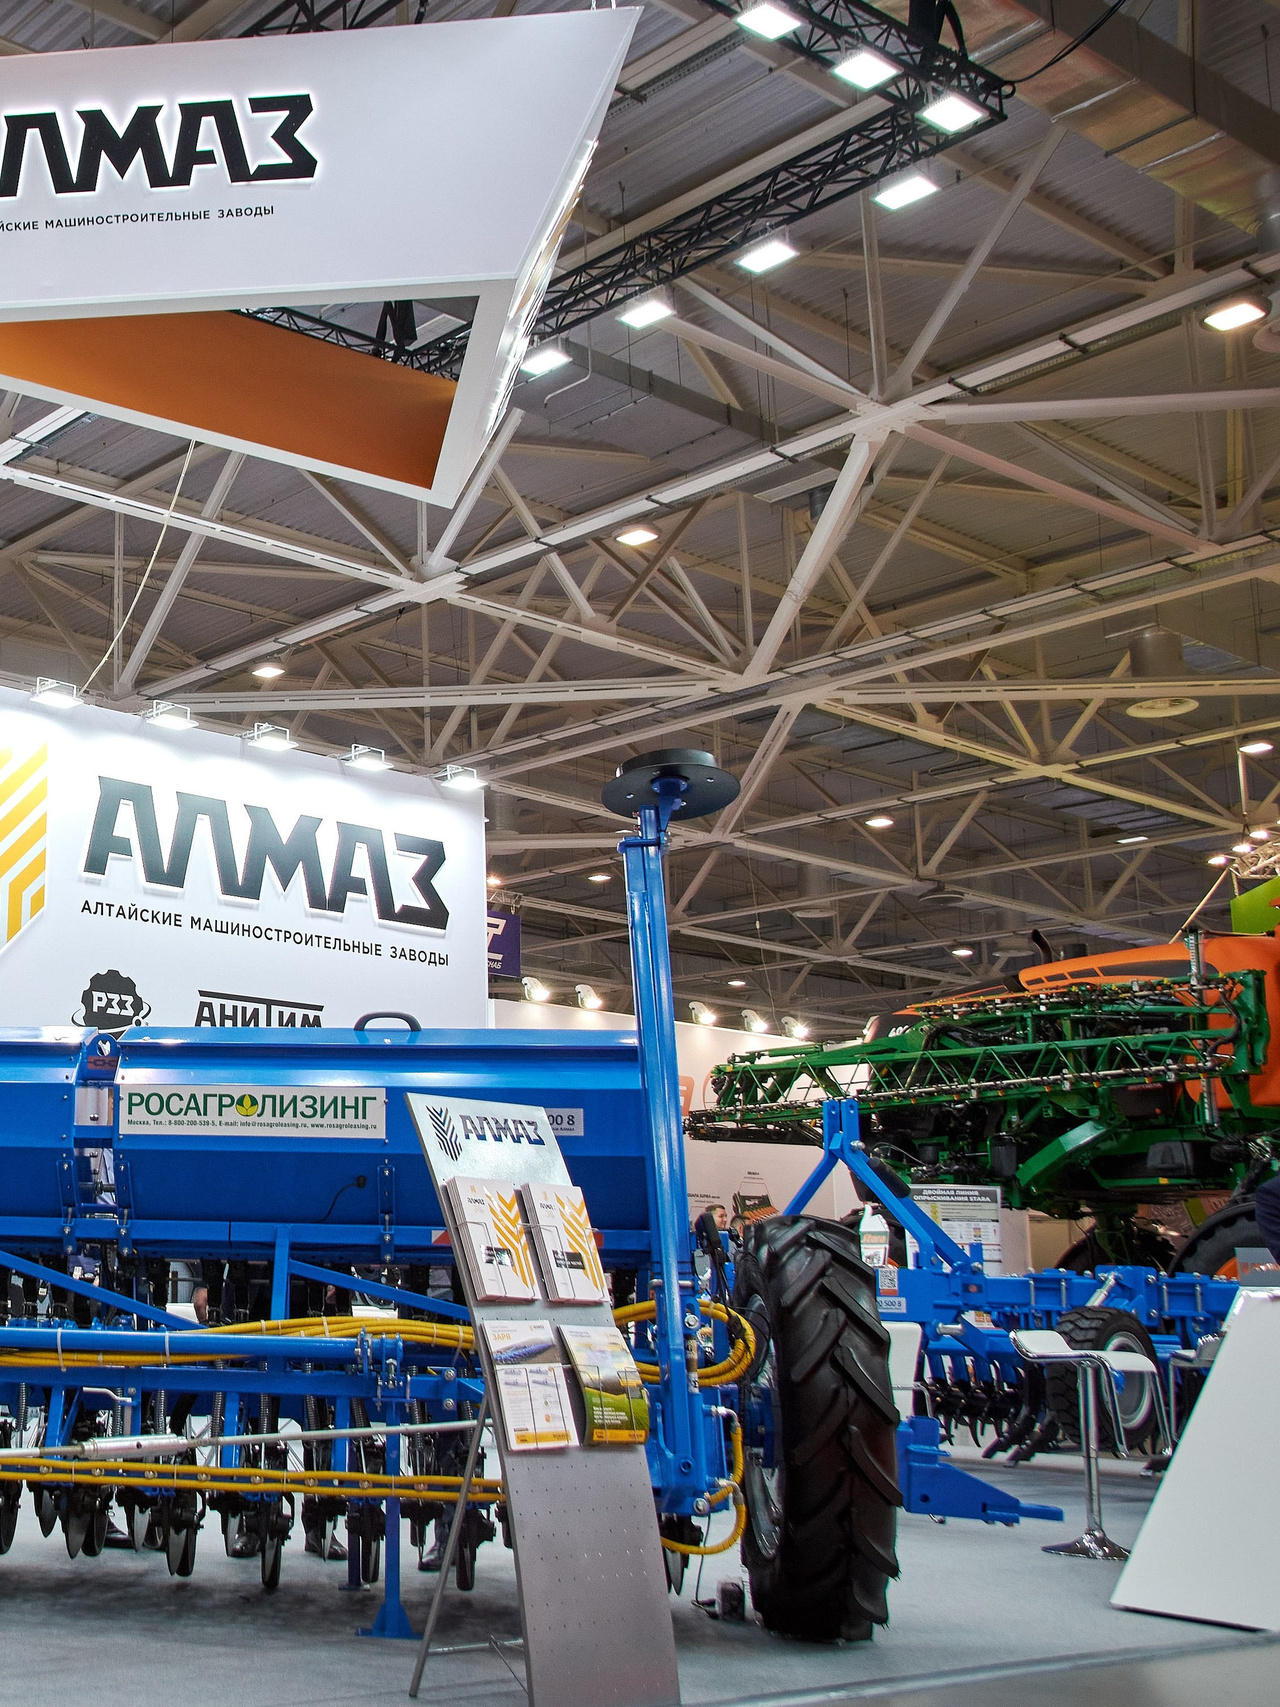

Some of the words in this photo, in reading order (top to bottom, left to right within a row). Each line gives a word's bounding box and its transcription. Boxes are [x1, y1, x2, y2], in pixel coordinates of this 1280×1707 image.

[45, 210, 211, 230] МАШИНОСТРОИТЕЛЬНЫЕ
[217, 205, 275, 219] ЗАВОДЫ
[83, 775, 450, 930] АЛМАЗ
[81, 899, 183, 928] АЛТАЙСКИЕ
[190, 916, 383, 957] МАШИНОСТРОИТЕЛЬНЫЕ
[389, 946, 450, 968] ЗАВОДЫ
[127, 1092, 377, 1119] РОСАГРОЛИЗИНГ
[548, 1114, 563, 1126] 00
[567, 1114, 575, 1126] 8
[459, 1114, 546, 1146] АЛМАЗ
